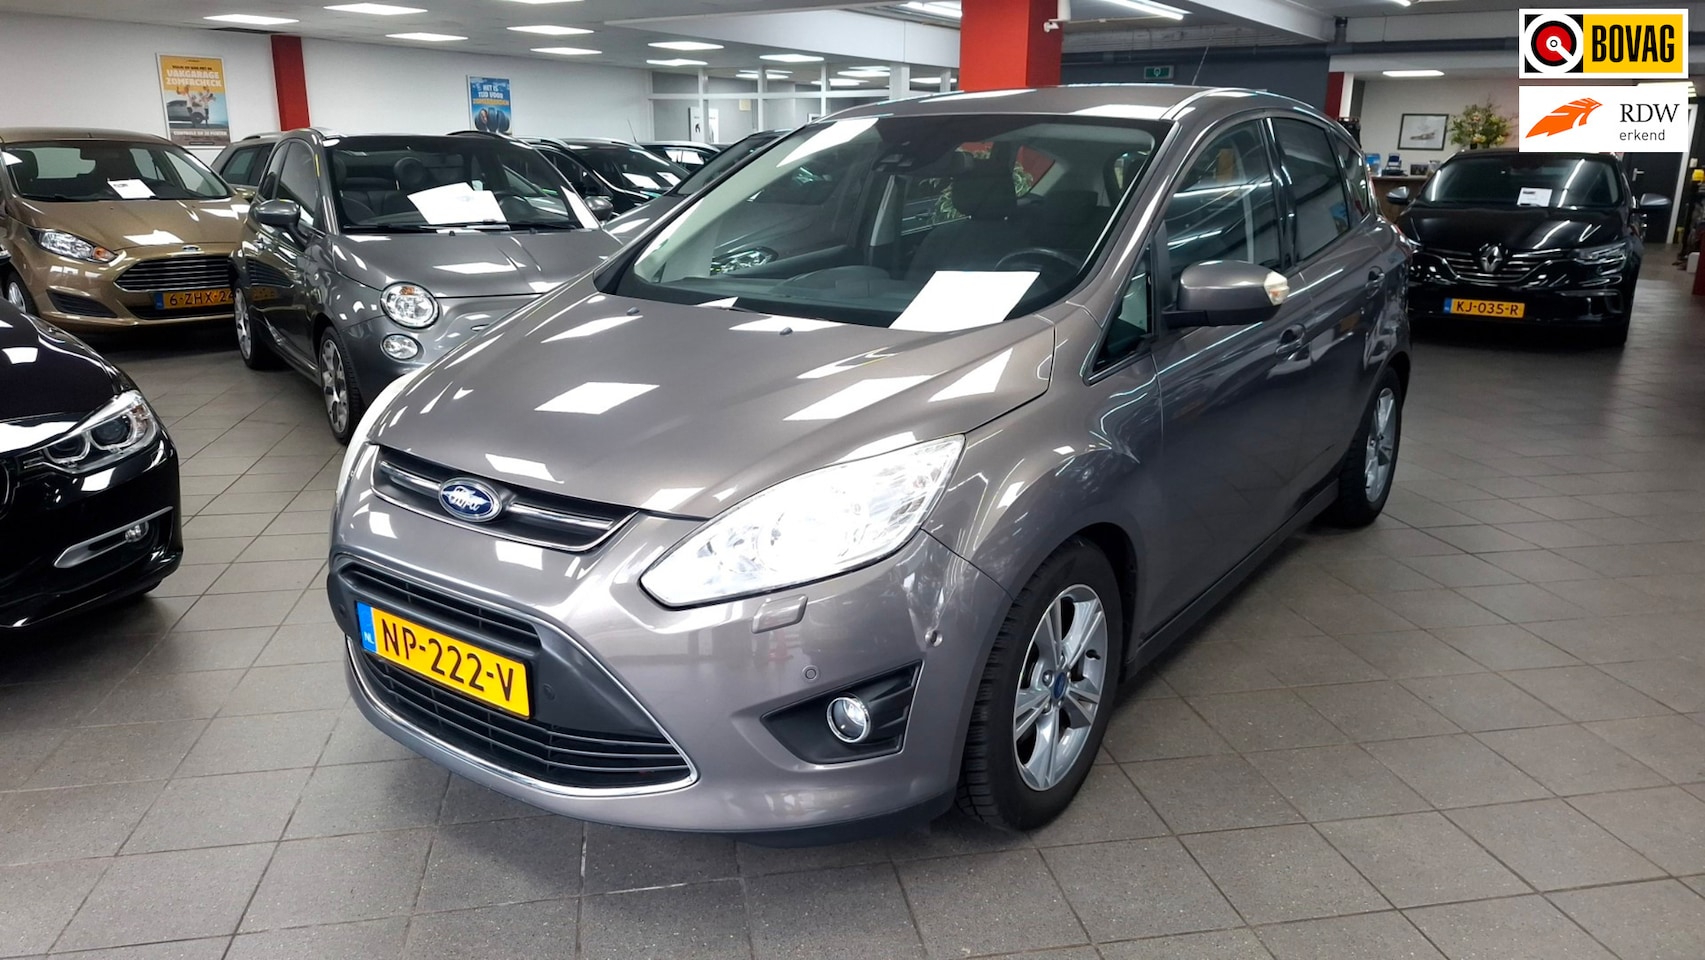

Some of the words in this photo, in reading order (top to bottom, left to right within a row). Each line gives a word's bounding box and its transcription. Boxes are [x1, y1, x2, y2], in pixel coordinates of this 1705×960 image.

[166, 69, 220, 79] VAKGARAGE
[165, 77, 222, 87] ZOMERCHECK
[1456, 301, 1519, 316] KJ-035-R
[363, 631, 375, 645] NL
[381, 618, 514, 702] NP-222-V
